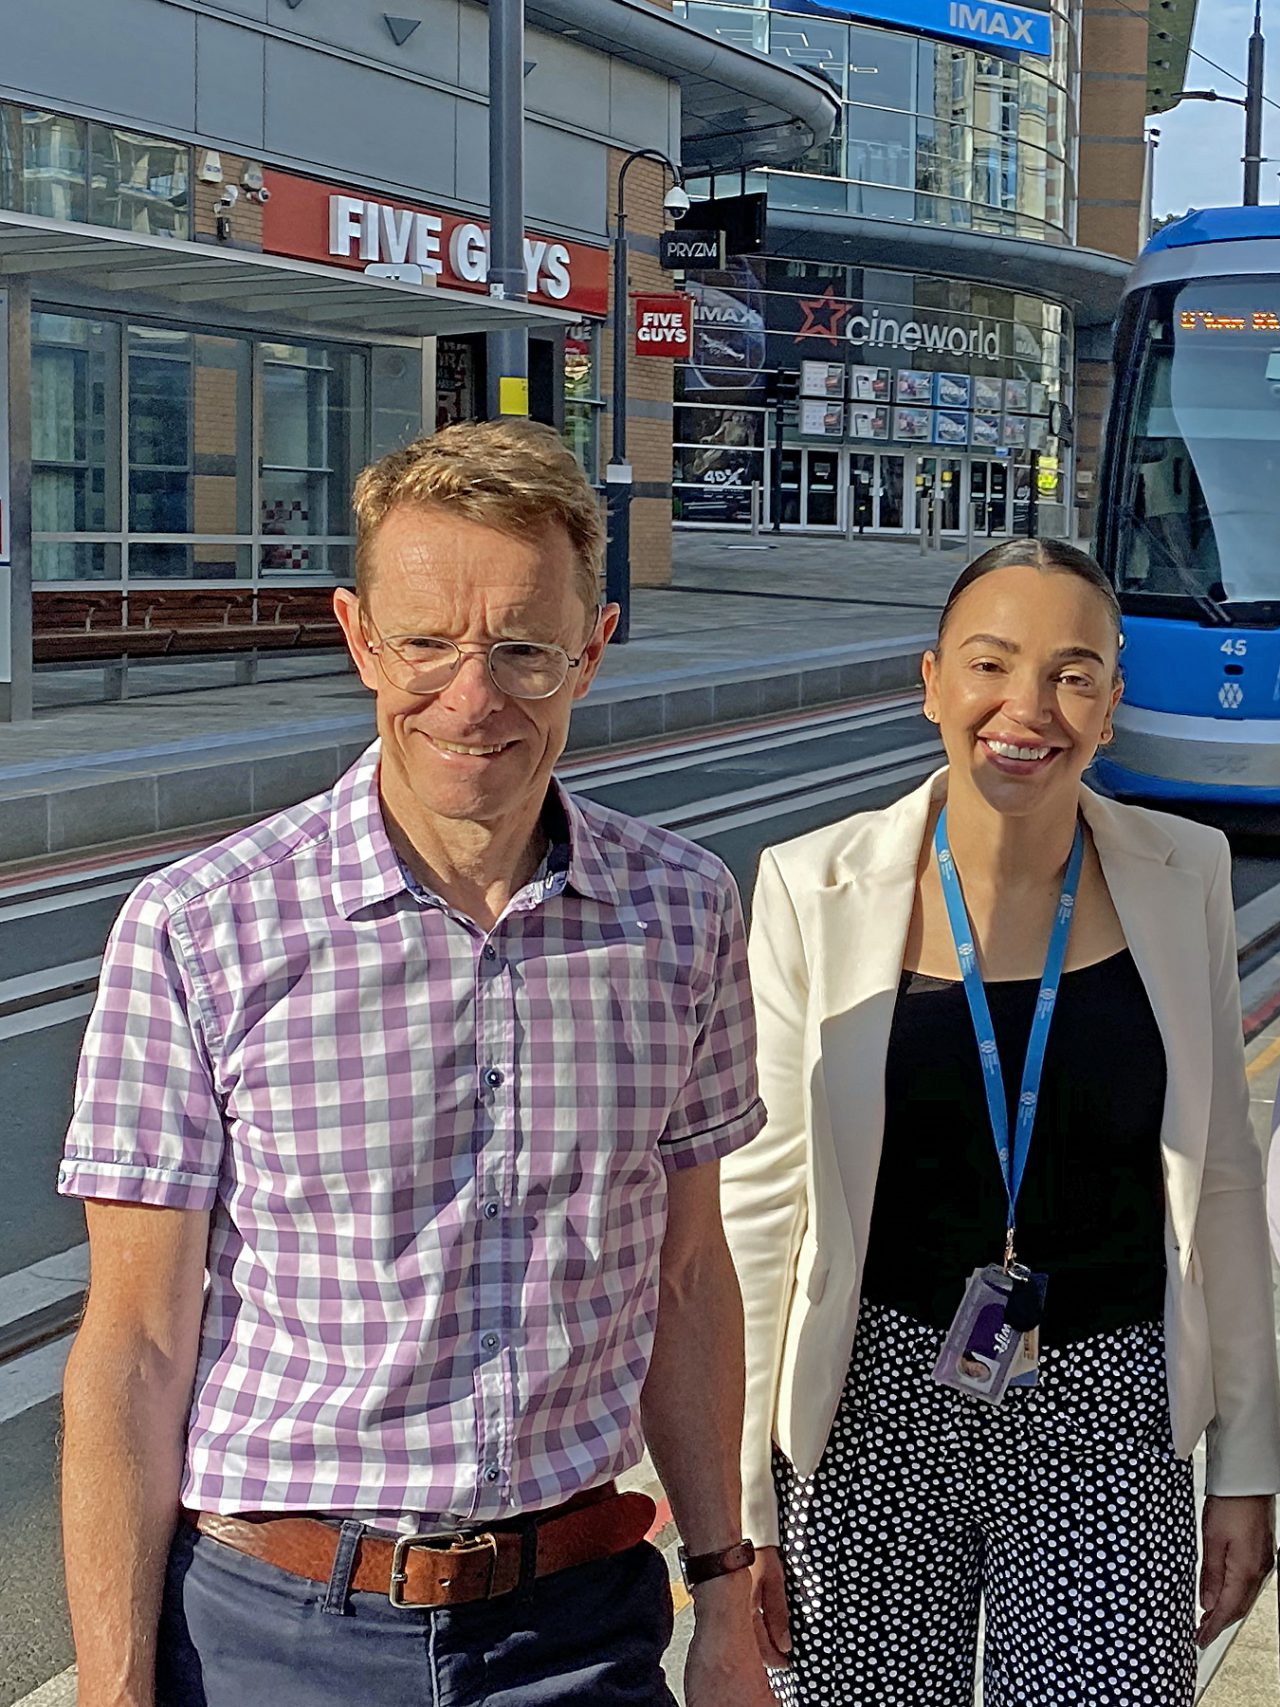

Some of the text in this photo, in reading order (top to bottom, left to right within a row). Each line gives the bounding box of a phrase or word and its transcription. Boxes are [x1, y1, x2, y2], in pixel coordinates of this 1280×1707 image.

[950, 2, 1034, 44] IMAX
[329, 194, 571, 300] FIVE GYS
[667, 242, 717, 258] PRYZM
[643, 312, 683, 328] FIVE
[694, 305, 757, 324] IMAX
[637, 327, 688, 343] GUYS
[846, 309, 1000, 361] cineworld
[1220, 639, 1247, 656] 45
